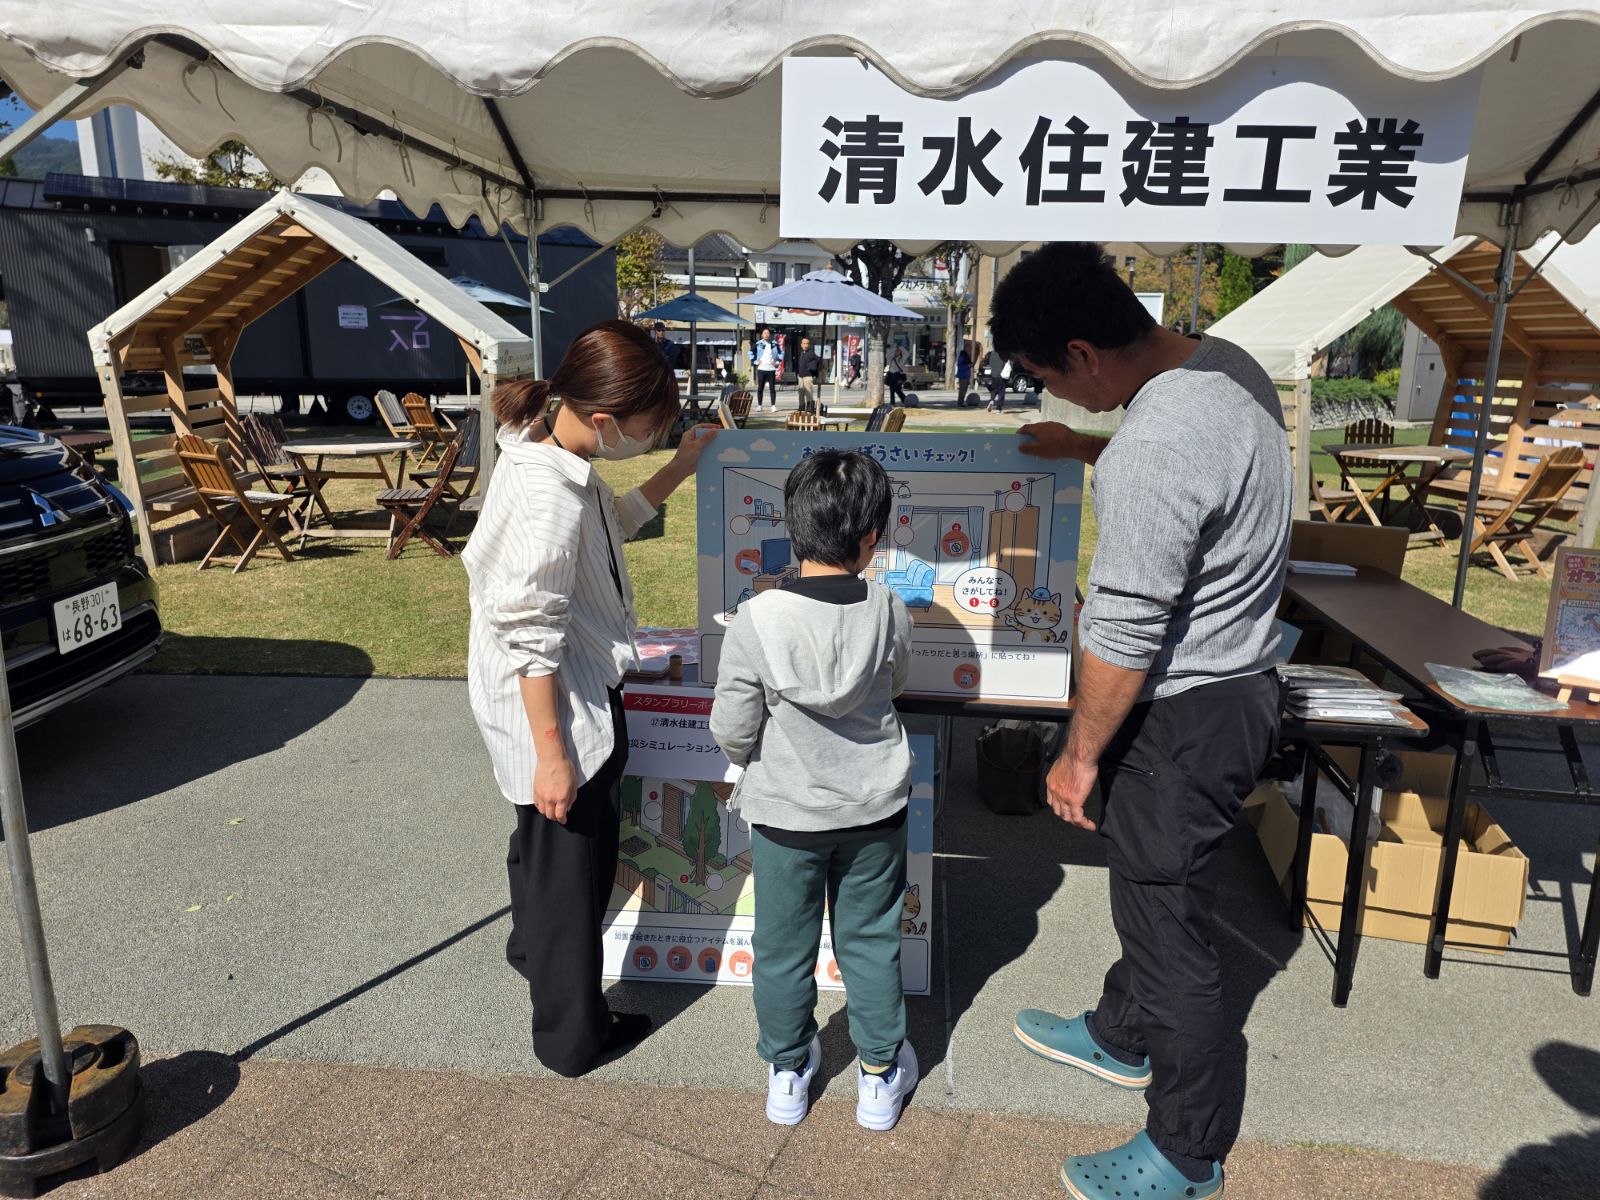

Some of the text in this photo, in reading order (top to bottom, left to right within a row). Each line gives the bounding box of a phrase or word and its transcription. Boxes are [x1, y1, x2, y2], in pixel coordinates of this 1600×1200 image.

[817, 114, 1424, 210] 清水住建工業
[389, 329, 430, 351] 入口
[968, 576, 1003, 585] みんなで
[962, 587, 1007, 596] さがしてね!
